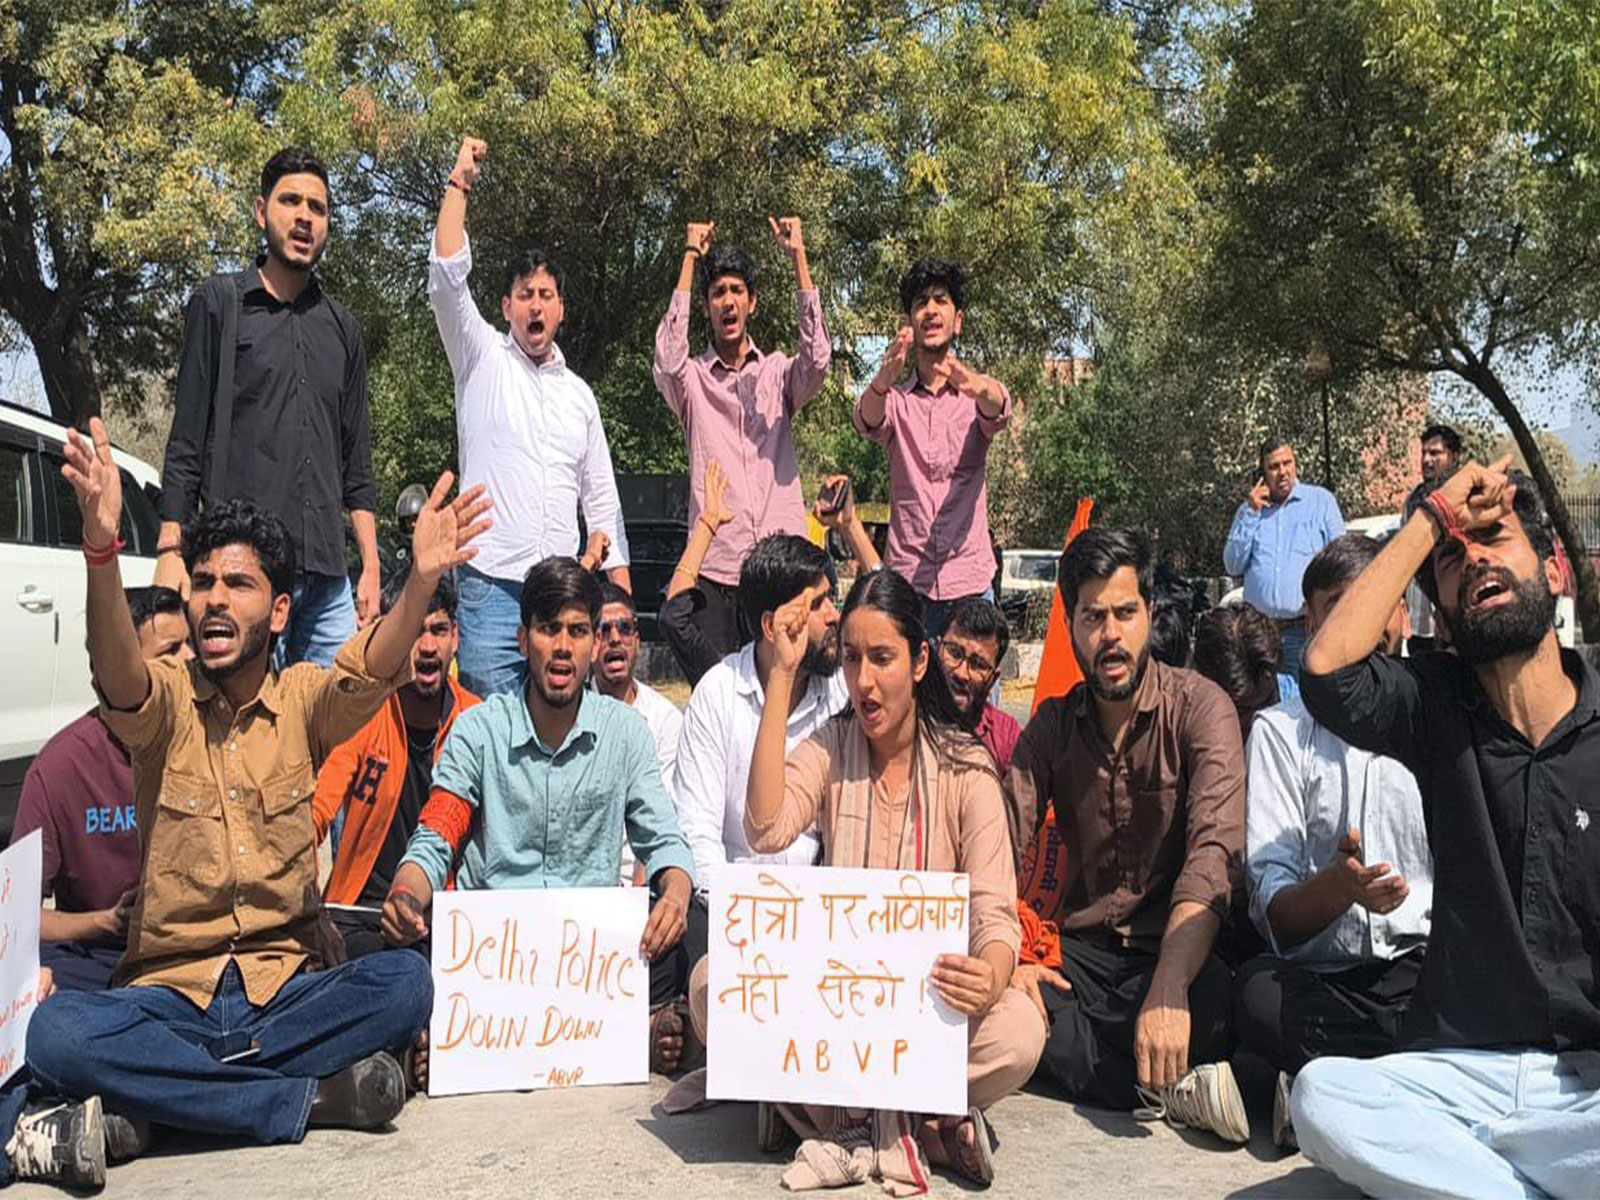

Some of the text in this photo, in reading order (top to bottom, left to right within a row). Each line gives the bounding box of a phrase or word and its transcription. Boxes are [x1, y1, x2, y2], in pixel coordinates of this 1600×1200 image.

[820, 893, 867, 939] पर
[868, 874, 967, 934] लाठीचार्ज
[441, 908, 635, 1000] Delhi Police
[436, 992, 604, 1049] DOWN DOWN
